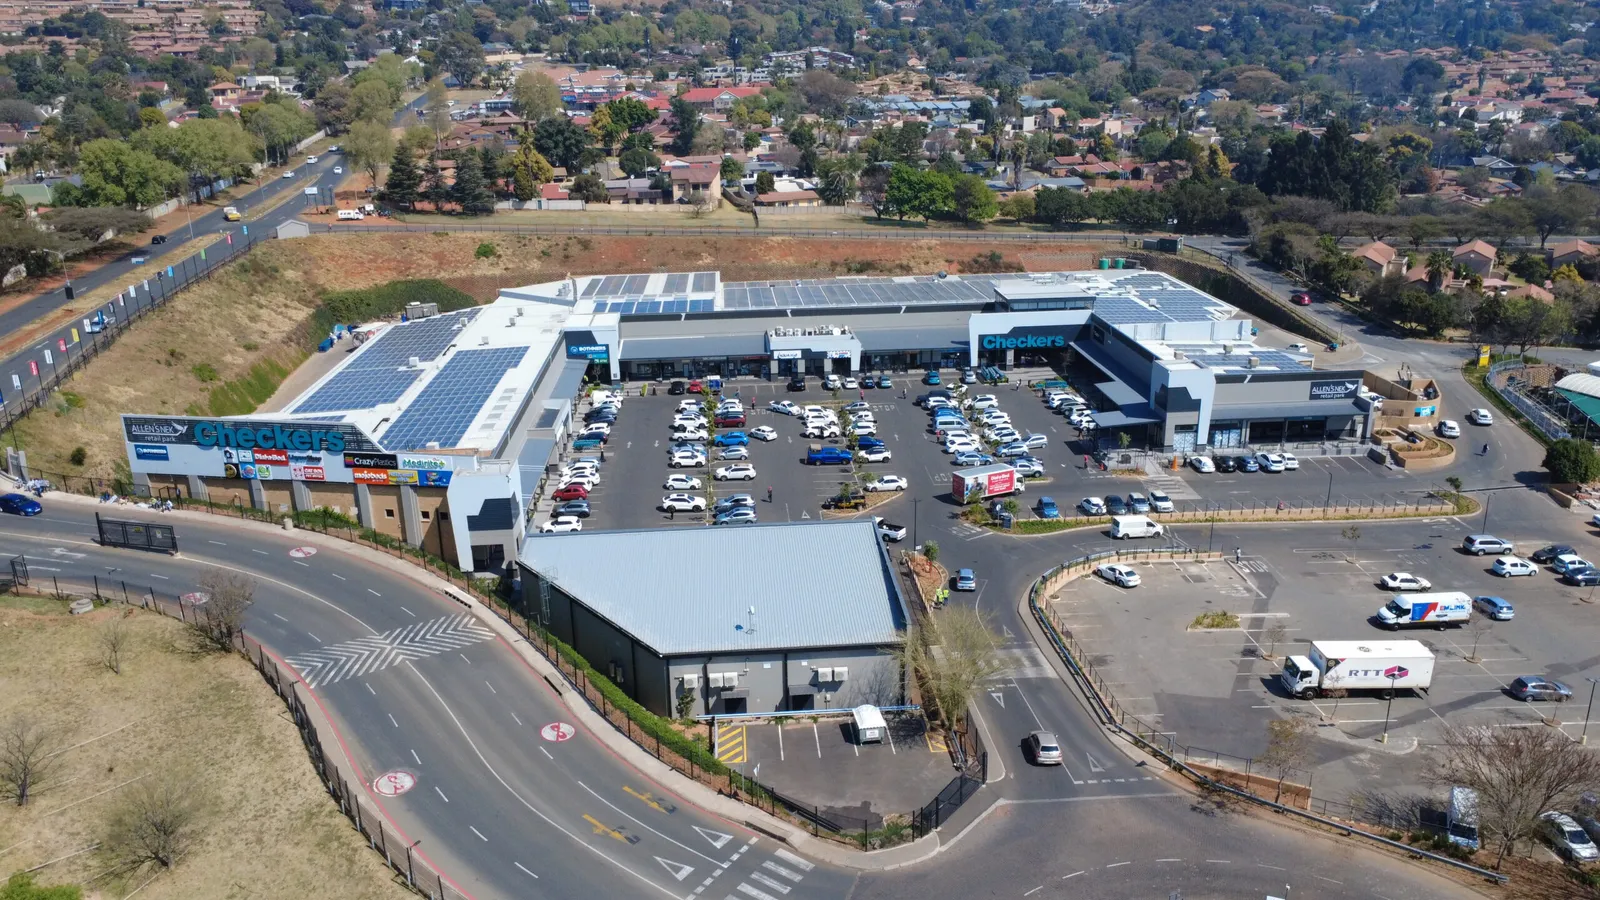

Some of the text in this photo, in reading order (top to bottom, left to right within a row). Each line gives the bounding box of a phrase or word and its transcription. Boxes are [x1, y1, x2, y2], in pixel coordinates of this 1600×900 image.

[983, 334, 1065, 349] Checkers
[160, 425, 175, 434] NEK
[193, 421, 345, 452] Checkers
[1238, 560, 1269, 573] STOP
[1348, 669, 1384, 677] RTT
